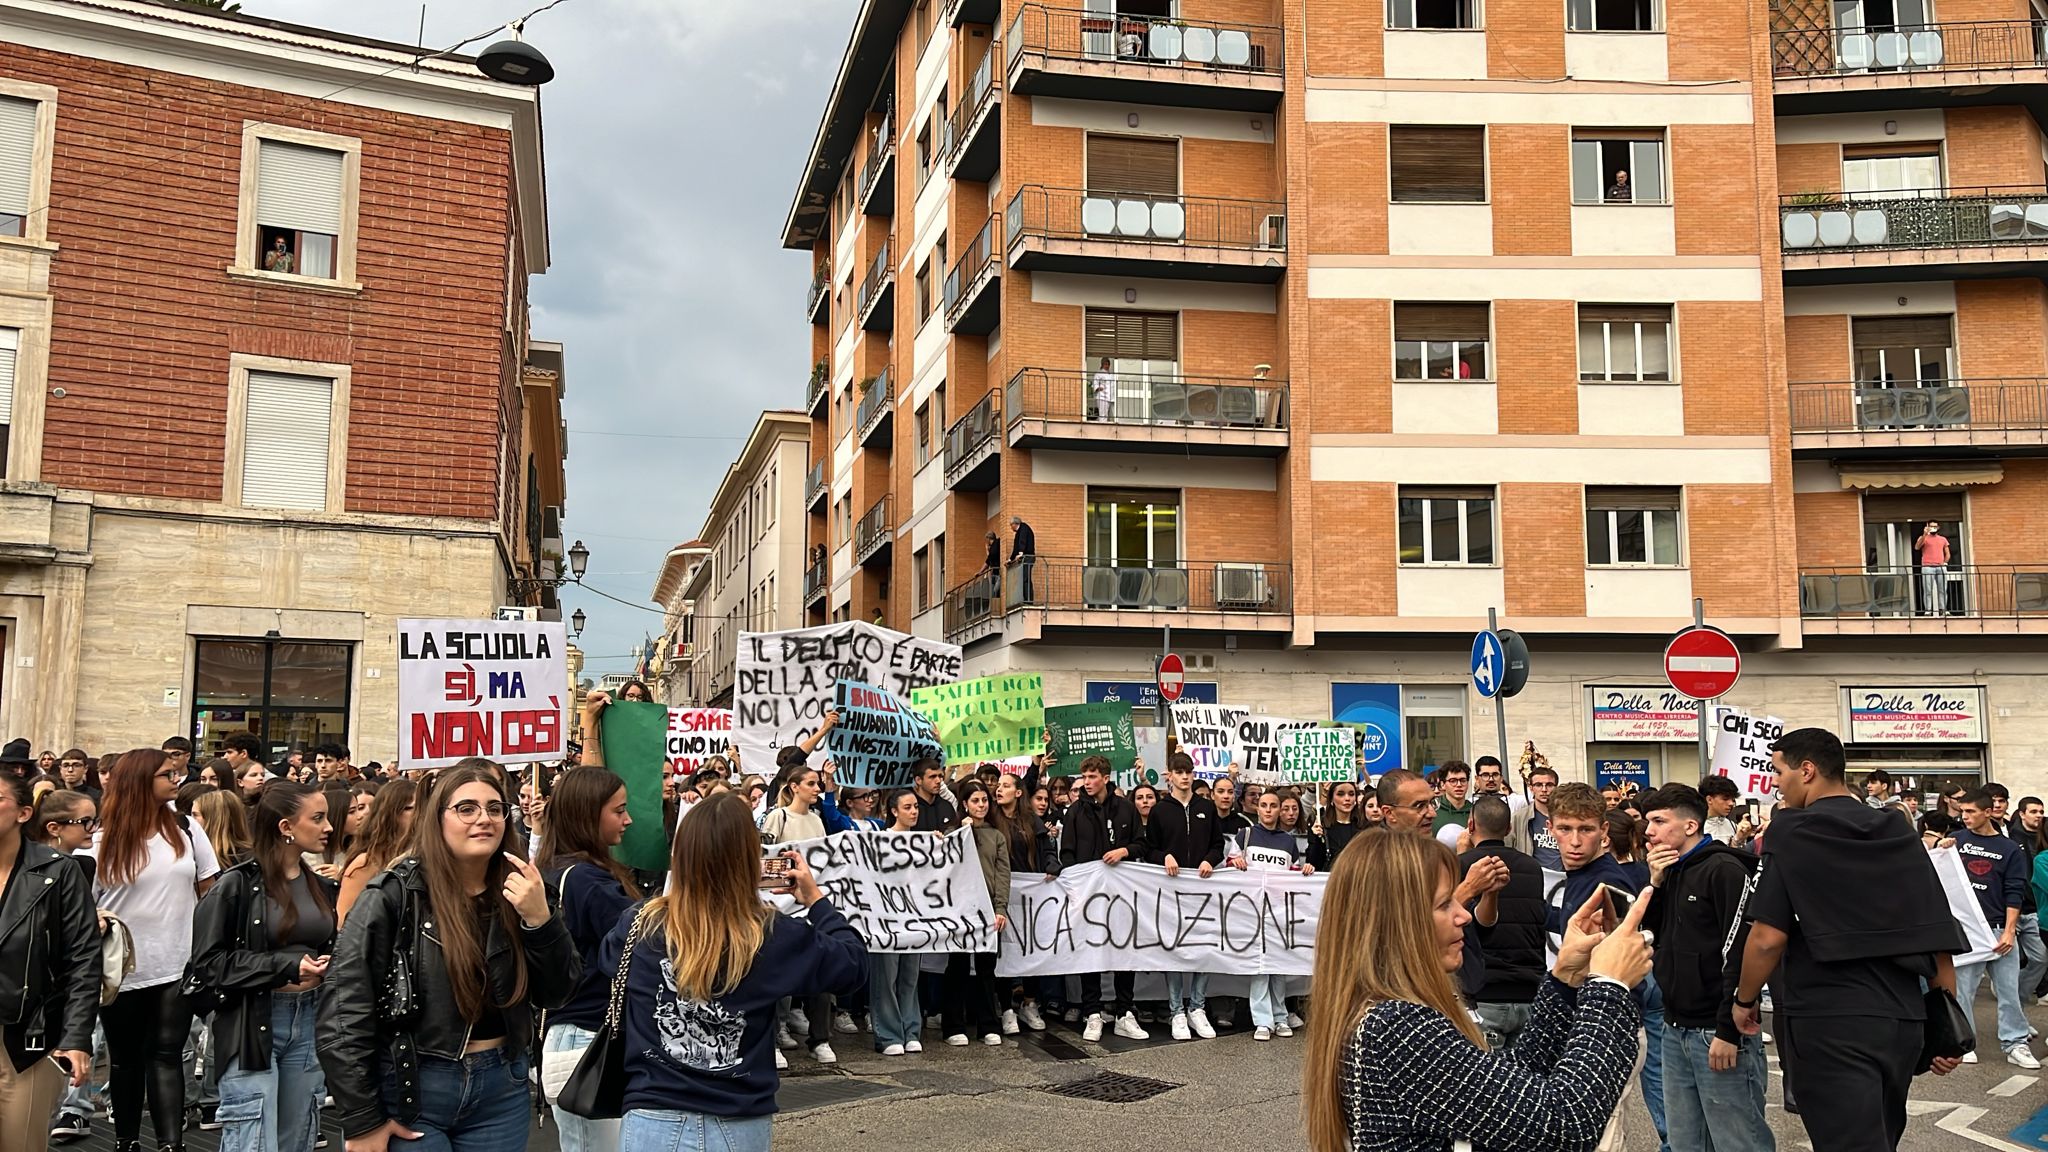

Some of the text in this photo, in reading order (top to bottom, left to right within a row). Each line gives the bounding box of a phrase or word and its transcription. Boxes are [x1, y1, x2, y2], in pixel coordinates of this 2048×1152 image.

[400, 632, 551, 660] LA SCUOLA
[751, 637, 771, 663] IL
[445, 663, 526, 706] SÌ, MA
[739, 665, 817, 695] DELLA
[836, 683, 847, 706] I
[1606, 692, 1698, 711] Della Noce
[1865, 693, 1965, 712] Della Noce
[738, 697, 834, 728] NOI VOG
[1204, 709, 1216, 725] IL
[411, 711, 494, 759] NON
[899, 716, 915, 738] LA
[1181, 727, 1228, 747] DIRITTO
[1239, 721, 1269, 744] QUI
[1752, 720, 1783, 740] SEQ
[665, 736, 729, 755] CINO, MA
[828, 730, 844, 752] LA
[848, 734, 899, 758] NOSTRA
[1295, 732, 1321, 745] EAT
[1325, 731, 1340, 745] IN
[1364, 734, 1381, 742] rgy
[1739, 737, 1755, 753] LA
[1285, 744, 1353, 758] POSTEROS
[1282, 757, 1352, 771] DELPHICA
[1740, 756, 1776, 772] SPEG
[1291, 770, 1349, 783] LAURUS
[1748, 774, 1772, 795] FU
[875, 882, 922, 917] NON
[923, 878, 953, 909] SI
[998, 888, 1315, 957] NICA SOLUZIONE
